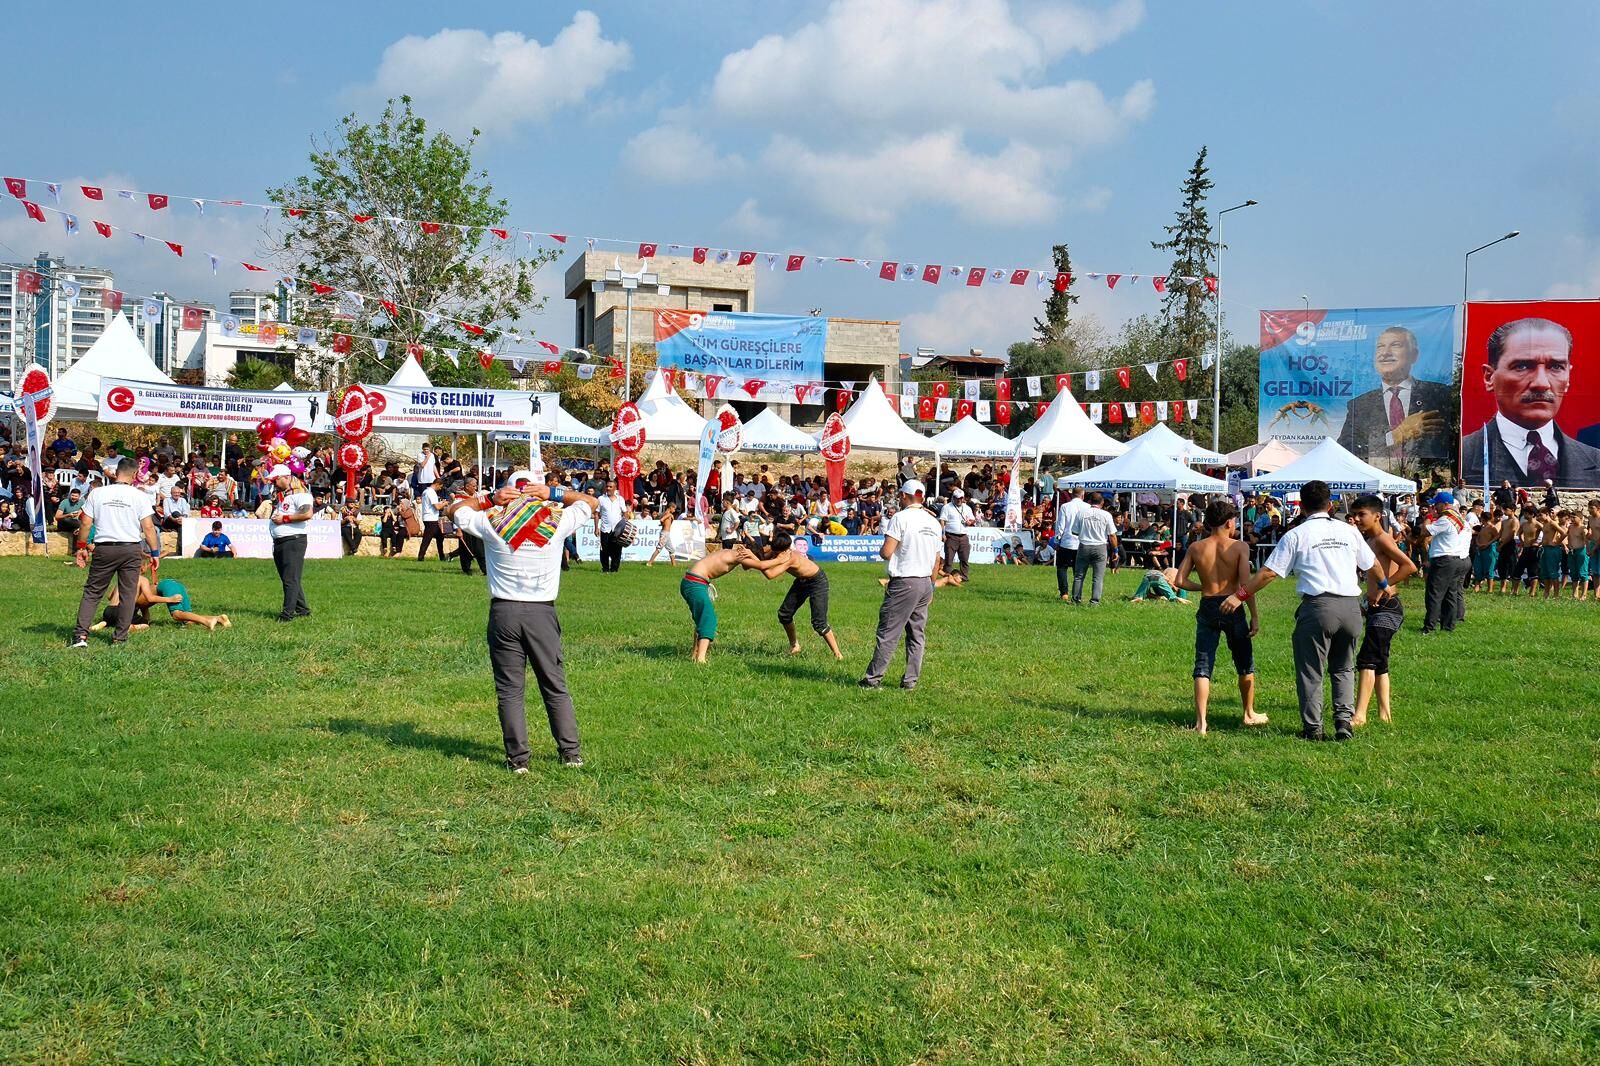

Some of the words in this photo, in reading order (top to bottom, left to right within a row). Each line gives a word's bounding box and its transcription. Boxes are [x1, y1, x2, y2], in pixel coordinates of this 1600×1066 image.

[720, 337, 802, 356] GÜREŞÇİLERE
[684, 353, 753, 369] BAŞARILAR
[755, 356, 804, 372] DİLERİM
[1288, 355, 1329, 375] HOŞ
[1263, 376, 1353, 396] GELDİNİZ
[146, 391, 178, 399] GELENEKSEL
[241, 396, 292, 406] PEHLİVANLARIMIZA
[411, 391, 438, 408] HOŞ
[441, 391, 495, 408] GELDİNİZ
[180, 400, 224, 411] BAŞARILAR
[225, 402, 253, 413] DİLERİZ
[409, 408, 441, 416] GELENEKSEL
[460, 409, 472, 417] ATLI
[473, 409, 502, 418] GÜREŞLERİ
[553, 435, 601, 444] BELEDİYESİ
[1084, 481, 1113, 489] KOZAN
[1116, 481, 1166, 489] BELEDİYESİ
[582, 525, 594, 534] Tü
[822, 545, 868, 553] BAŞARILAR
[970, 543, 1001, 553] ilerim
